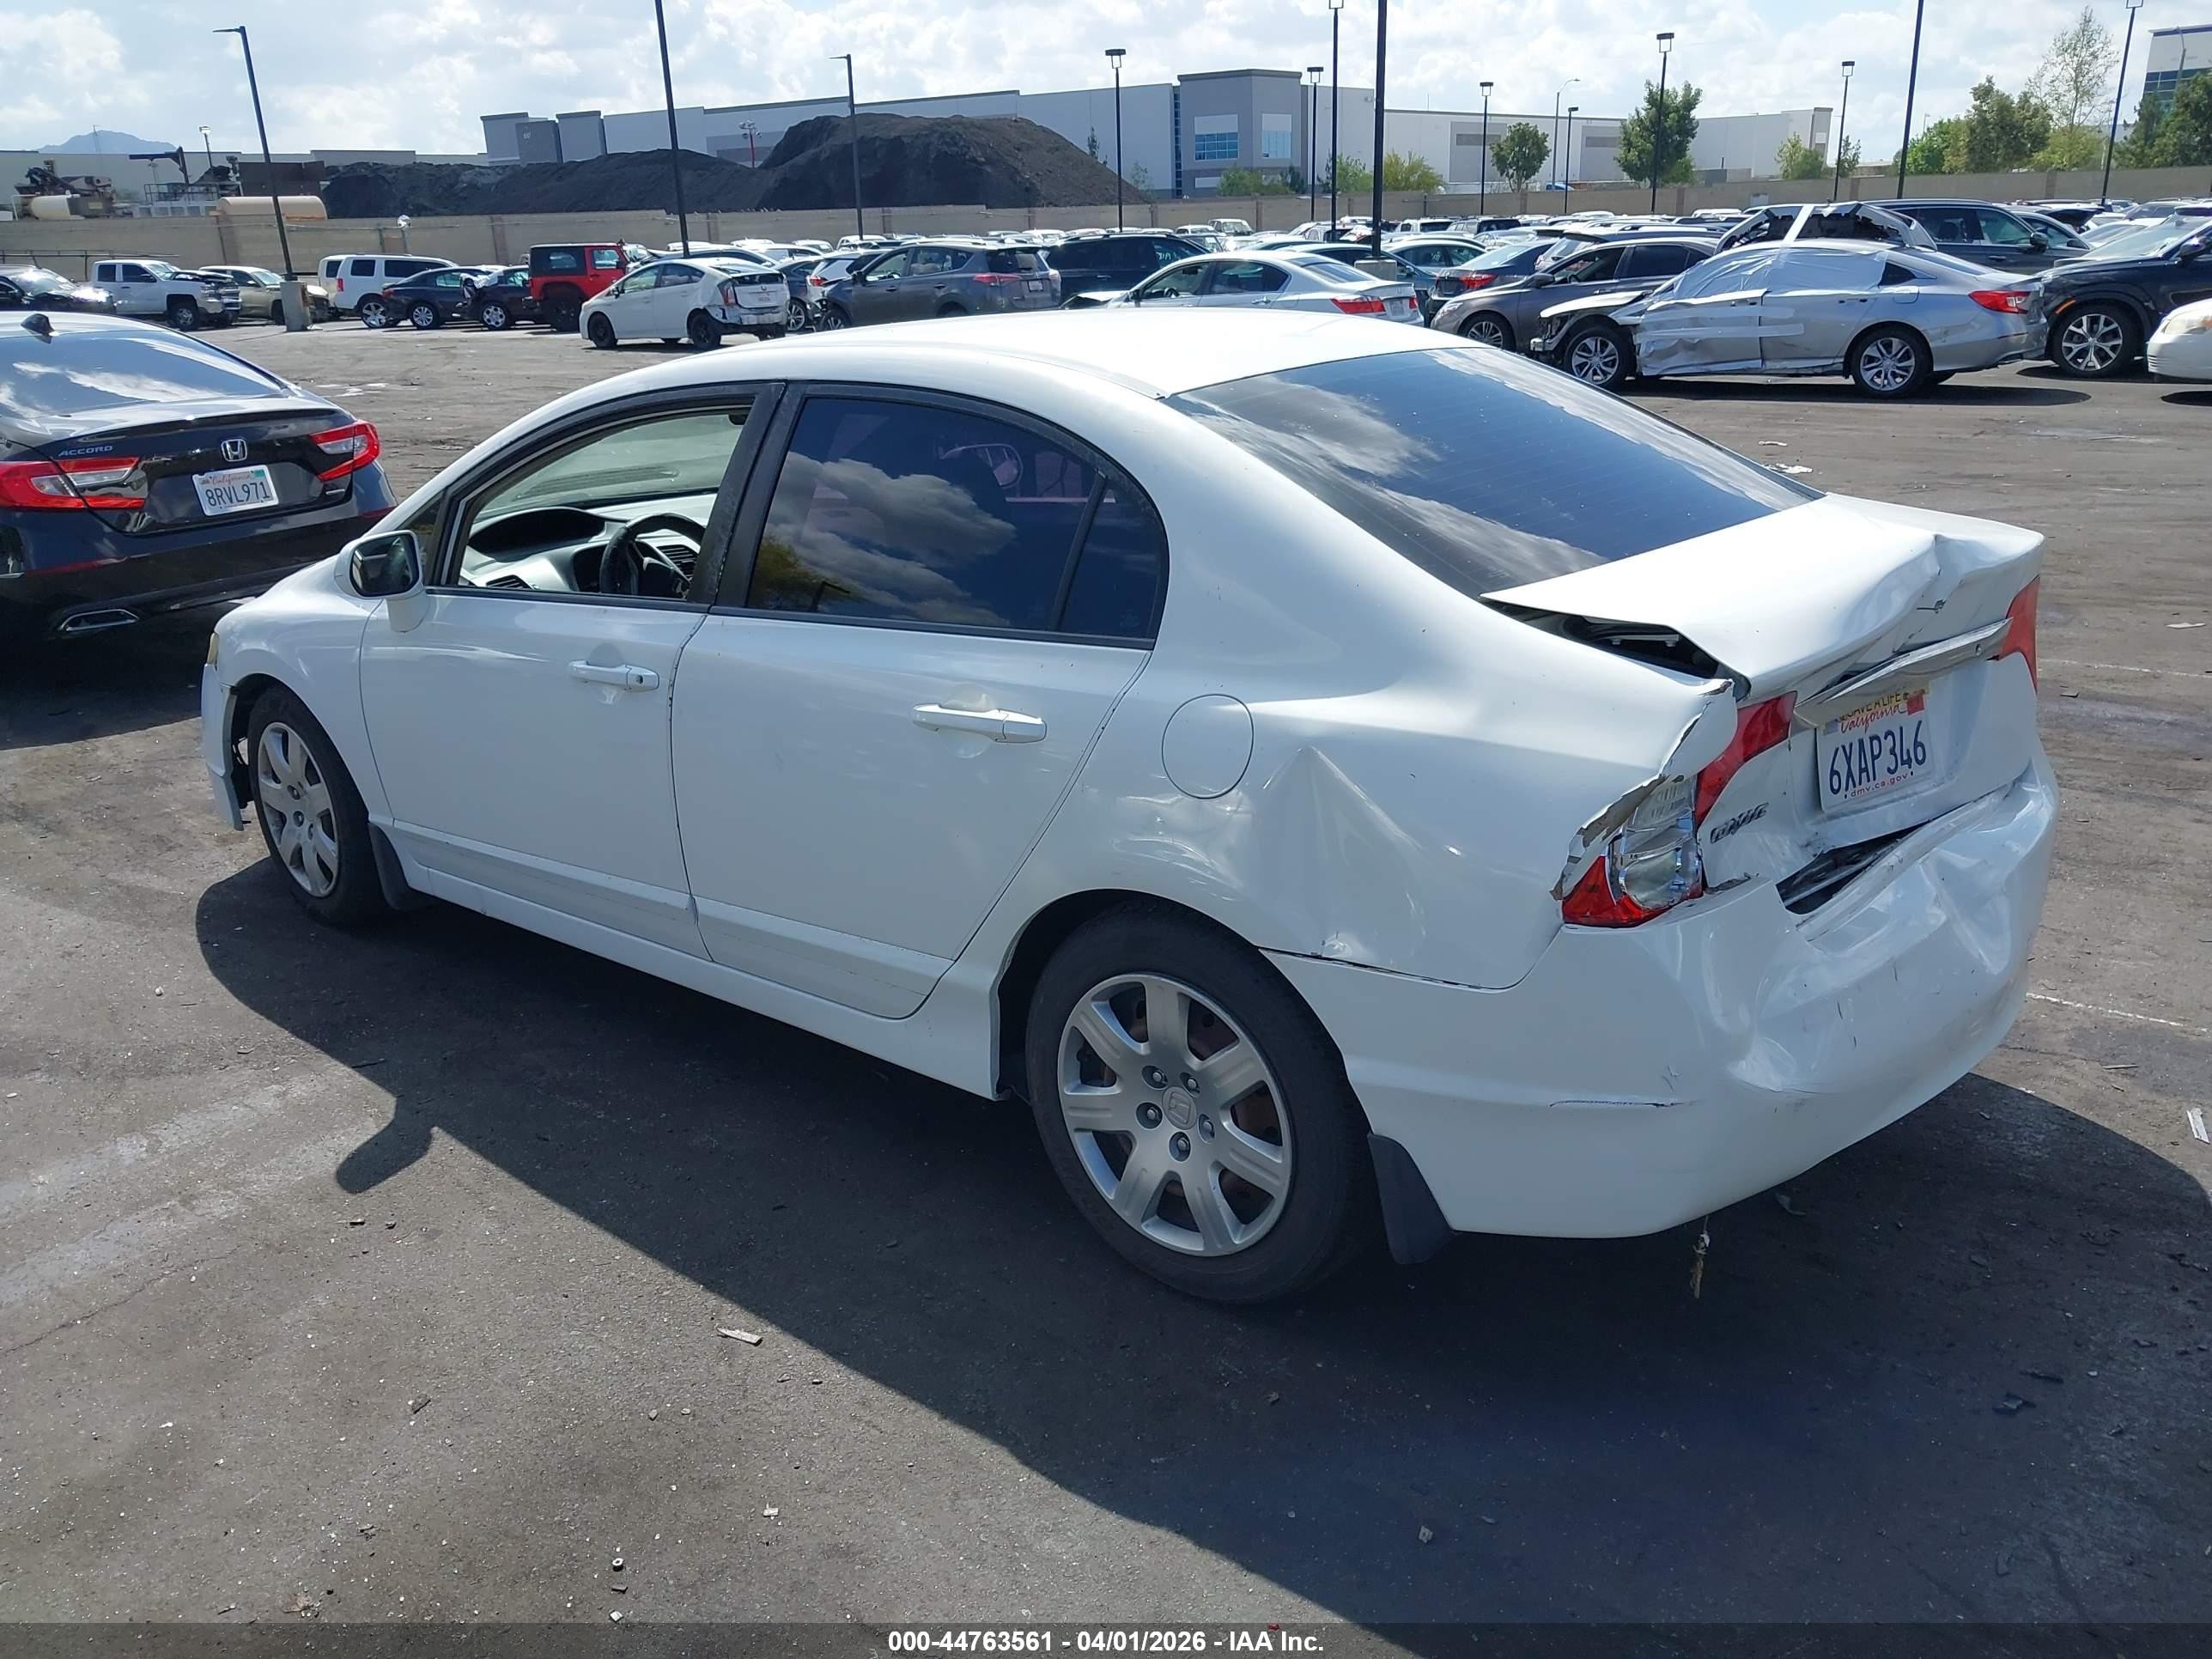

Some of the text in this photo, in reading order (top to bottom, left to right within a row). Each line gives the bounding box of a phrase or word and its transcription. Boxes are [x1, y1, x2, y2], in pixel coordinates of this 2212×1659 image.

[58, 445, 113, 457] ACCORD
[205, 482, 270, 507] 8RVL971
[1840, 703, 1908, 734] California
[1829, 720, 1927, 795] 6XAP346
[1850, 774, 1908, 798] dmv.ca.gov
